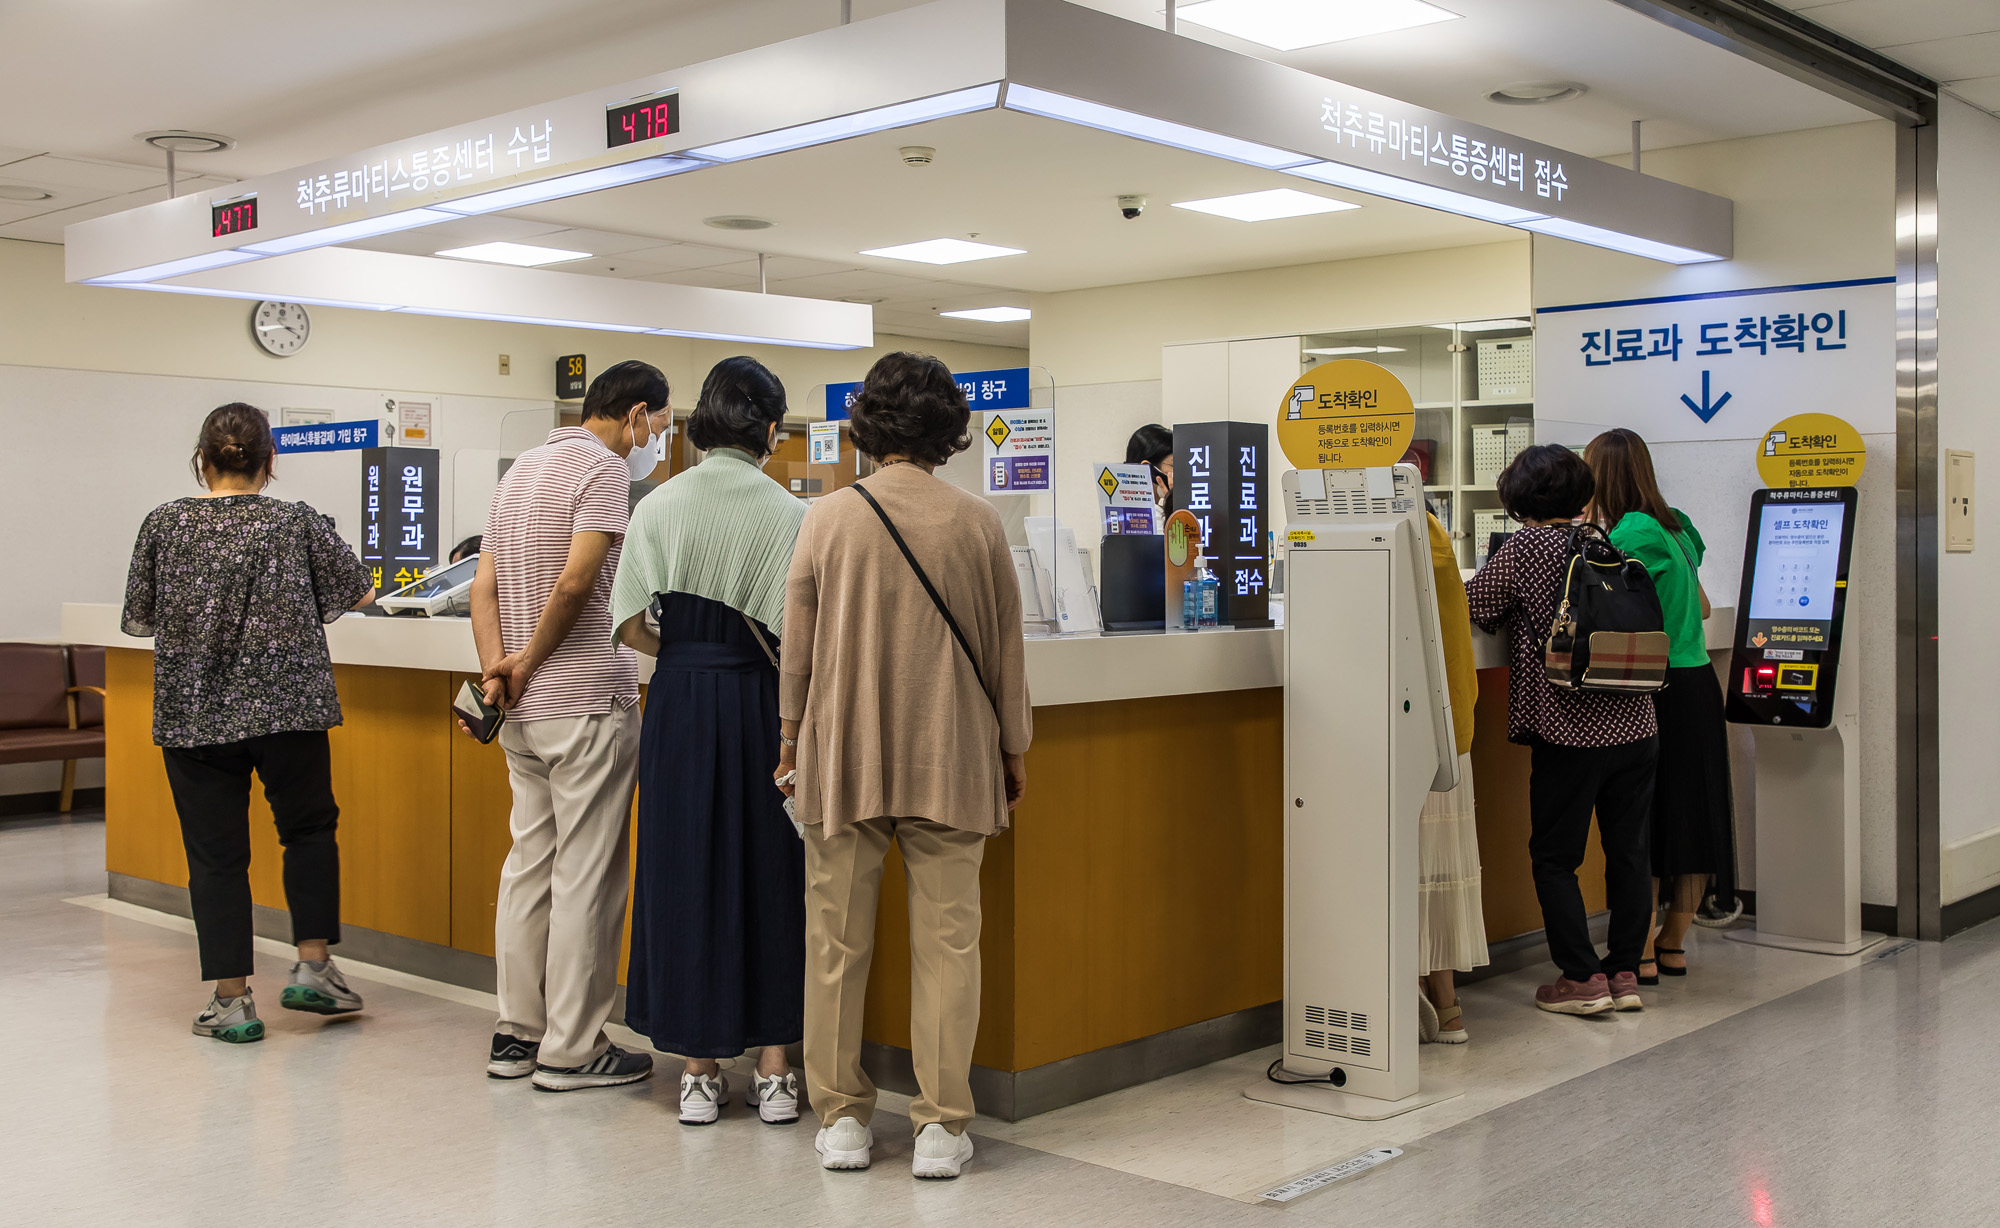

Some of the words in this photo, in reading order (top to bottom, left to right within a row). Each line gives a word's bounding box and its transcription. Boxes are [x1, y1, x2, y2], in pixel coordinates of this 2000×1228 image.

[621, 102, 669, 143] 478
[1320, 97, 1524, 192] 척추류마티스통증센터
[1534, 158, 1569, 202] 접수
[296, 132, 495, 216] 척추류마티스통증센터
[506, 118, 553, 168] 수납
[221, 203, 252, 234] 477
[1580, 323, 1683, 367] 진료과
[1696, 310, 1847, 356] 도착확인
[568, 357, 583, 376] 58
[981, 380, 1007, 401] 창구
[1317, 389, 1378, 410] 도착확인
[280, 429, 336, 448] 하이패스(후불결제)
[337, 428, 352, 444] 가입
[353, 427, 368, 443] 창구
[1317, 422, 1357, 435] 등록번호를
[1359, 421, 1400, 433] 입력하시면
[1317, 438, 1350, 450] 자동으로
[1351, 436, 1392, 448] 도착확인이
[1788, 434, 1837, 449] 도착확인
[1317, 453, 1344, 464] 됩니다.
[1788, 458, 1820, 467] 등록번호를
[1822, 457, 1855, 466] 입력하시면
[1788, 469, 1814, 478] 자동으로
[1816, 467, 1849, 477] 도착확인이
[1239, 445, 1258, 548] 진료과
[367, 465, 380, 550] 원무과
[401, 465, 425, 550] 원무과
[1773, 520, 1791, 530] 셀프
[1793, 519, 1829, 530] 도착확인
[1234, 568, 1264, 595] 접수
